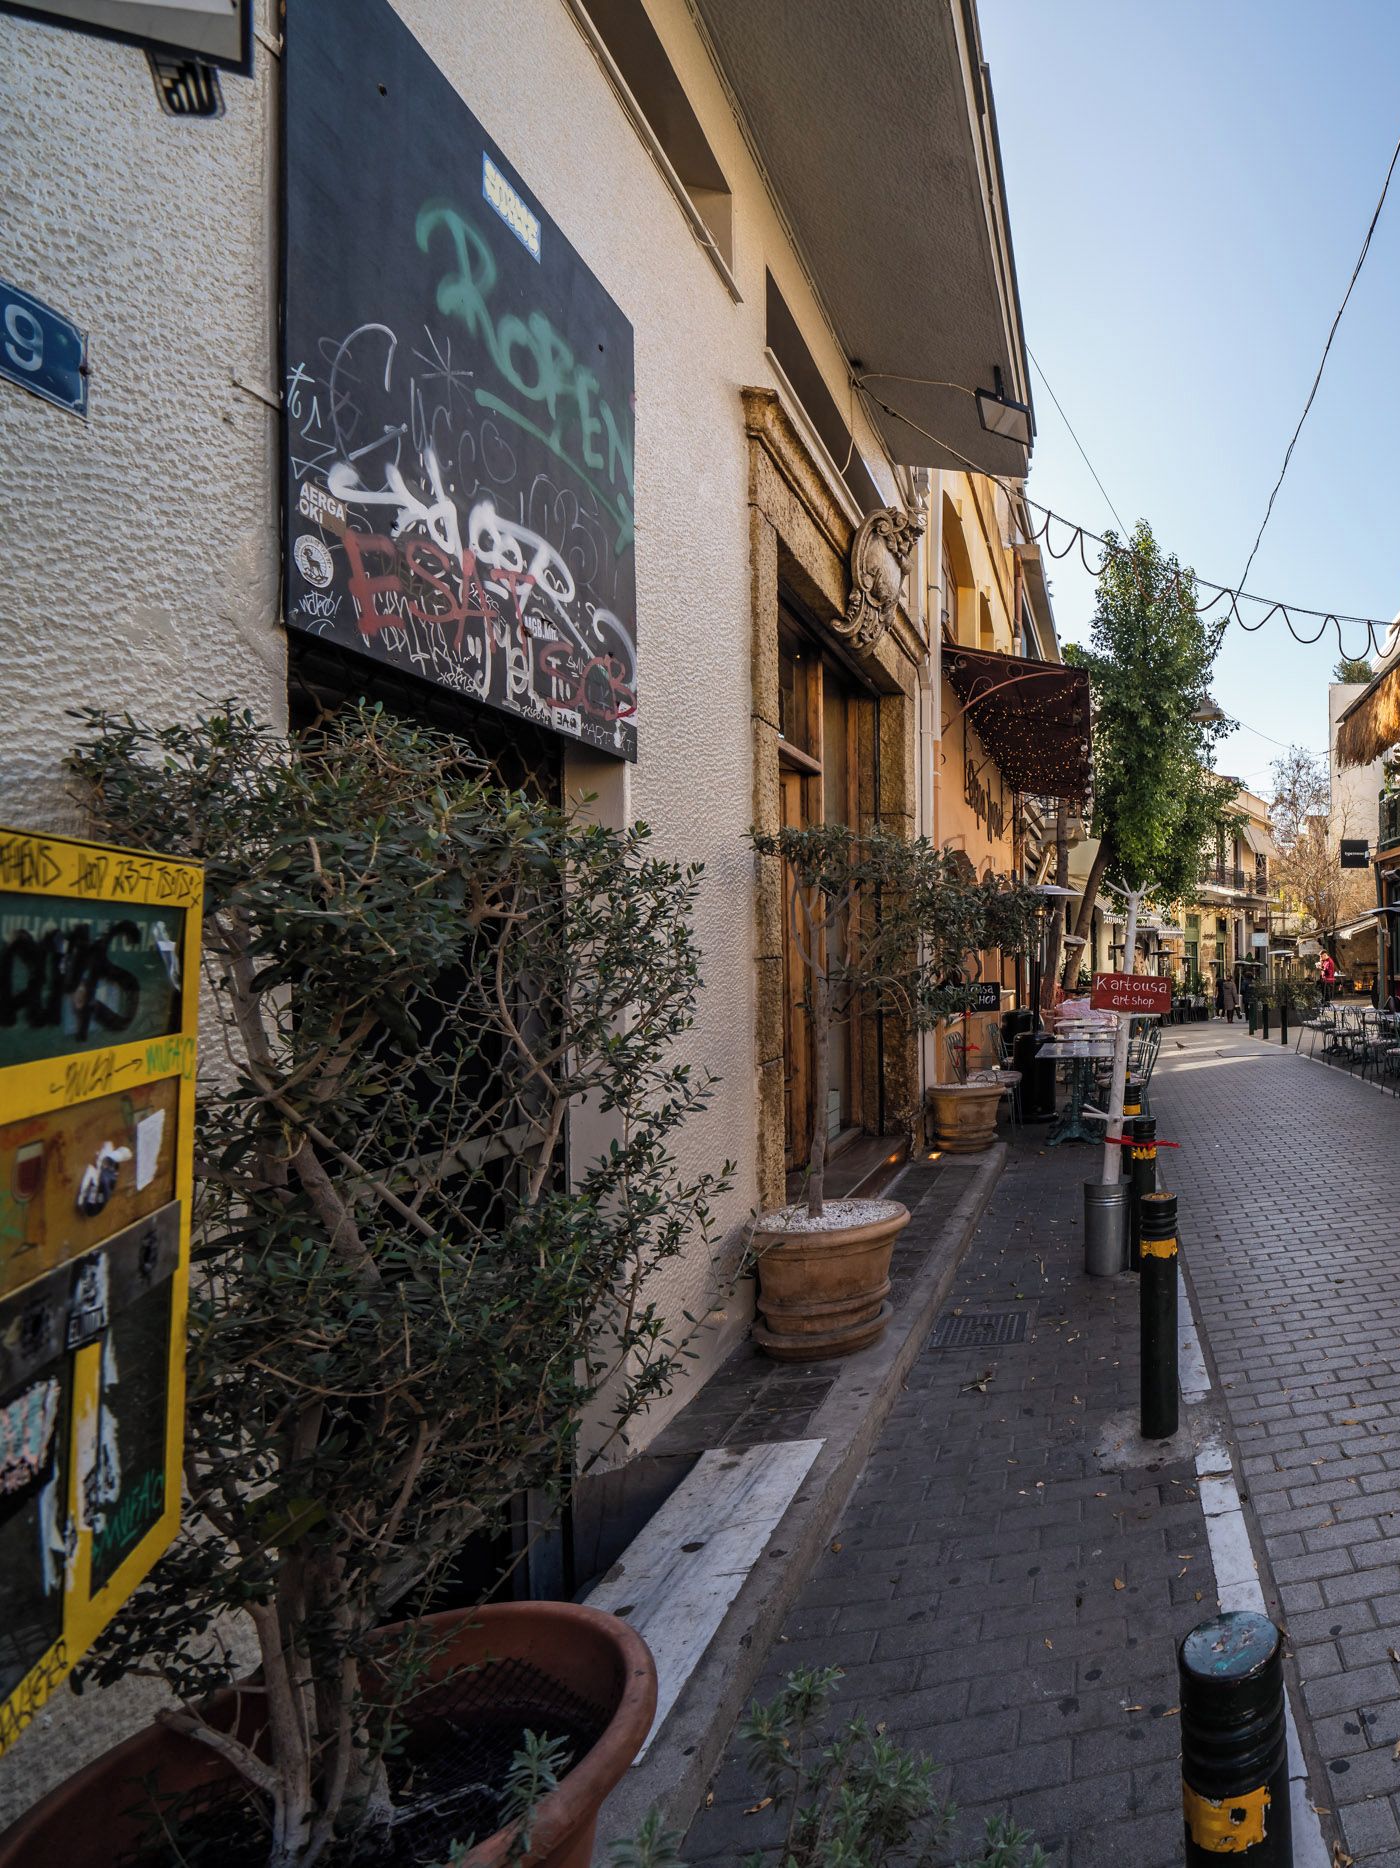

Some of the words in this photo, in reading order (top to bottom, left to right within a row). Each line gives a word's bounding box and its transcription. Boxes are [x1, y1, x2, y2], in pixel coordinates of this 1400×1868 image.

[4, 303, 43, 371] 9
[300, 481, 346, 522] AERGA
[1096, 976, 1167, 993] Kartousa
[978, 995, 997, 1005] HOP
[1112, 995, 1130, 1006] art
[1131, 996, 1155, 1008] shop
